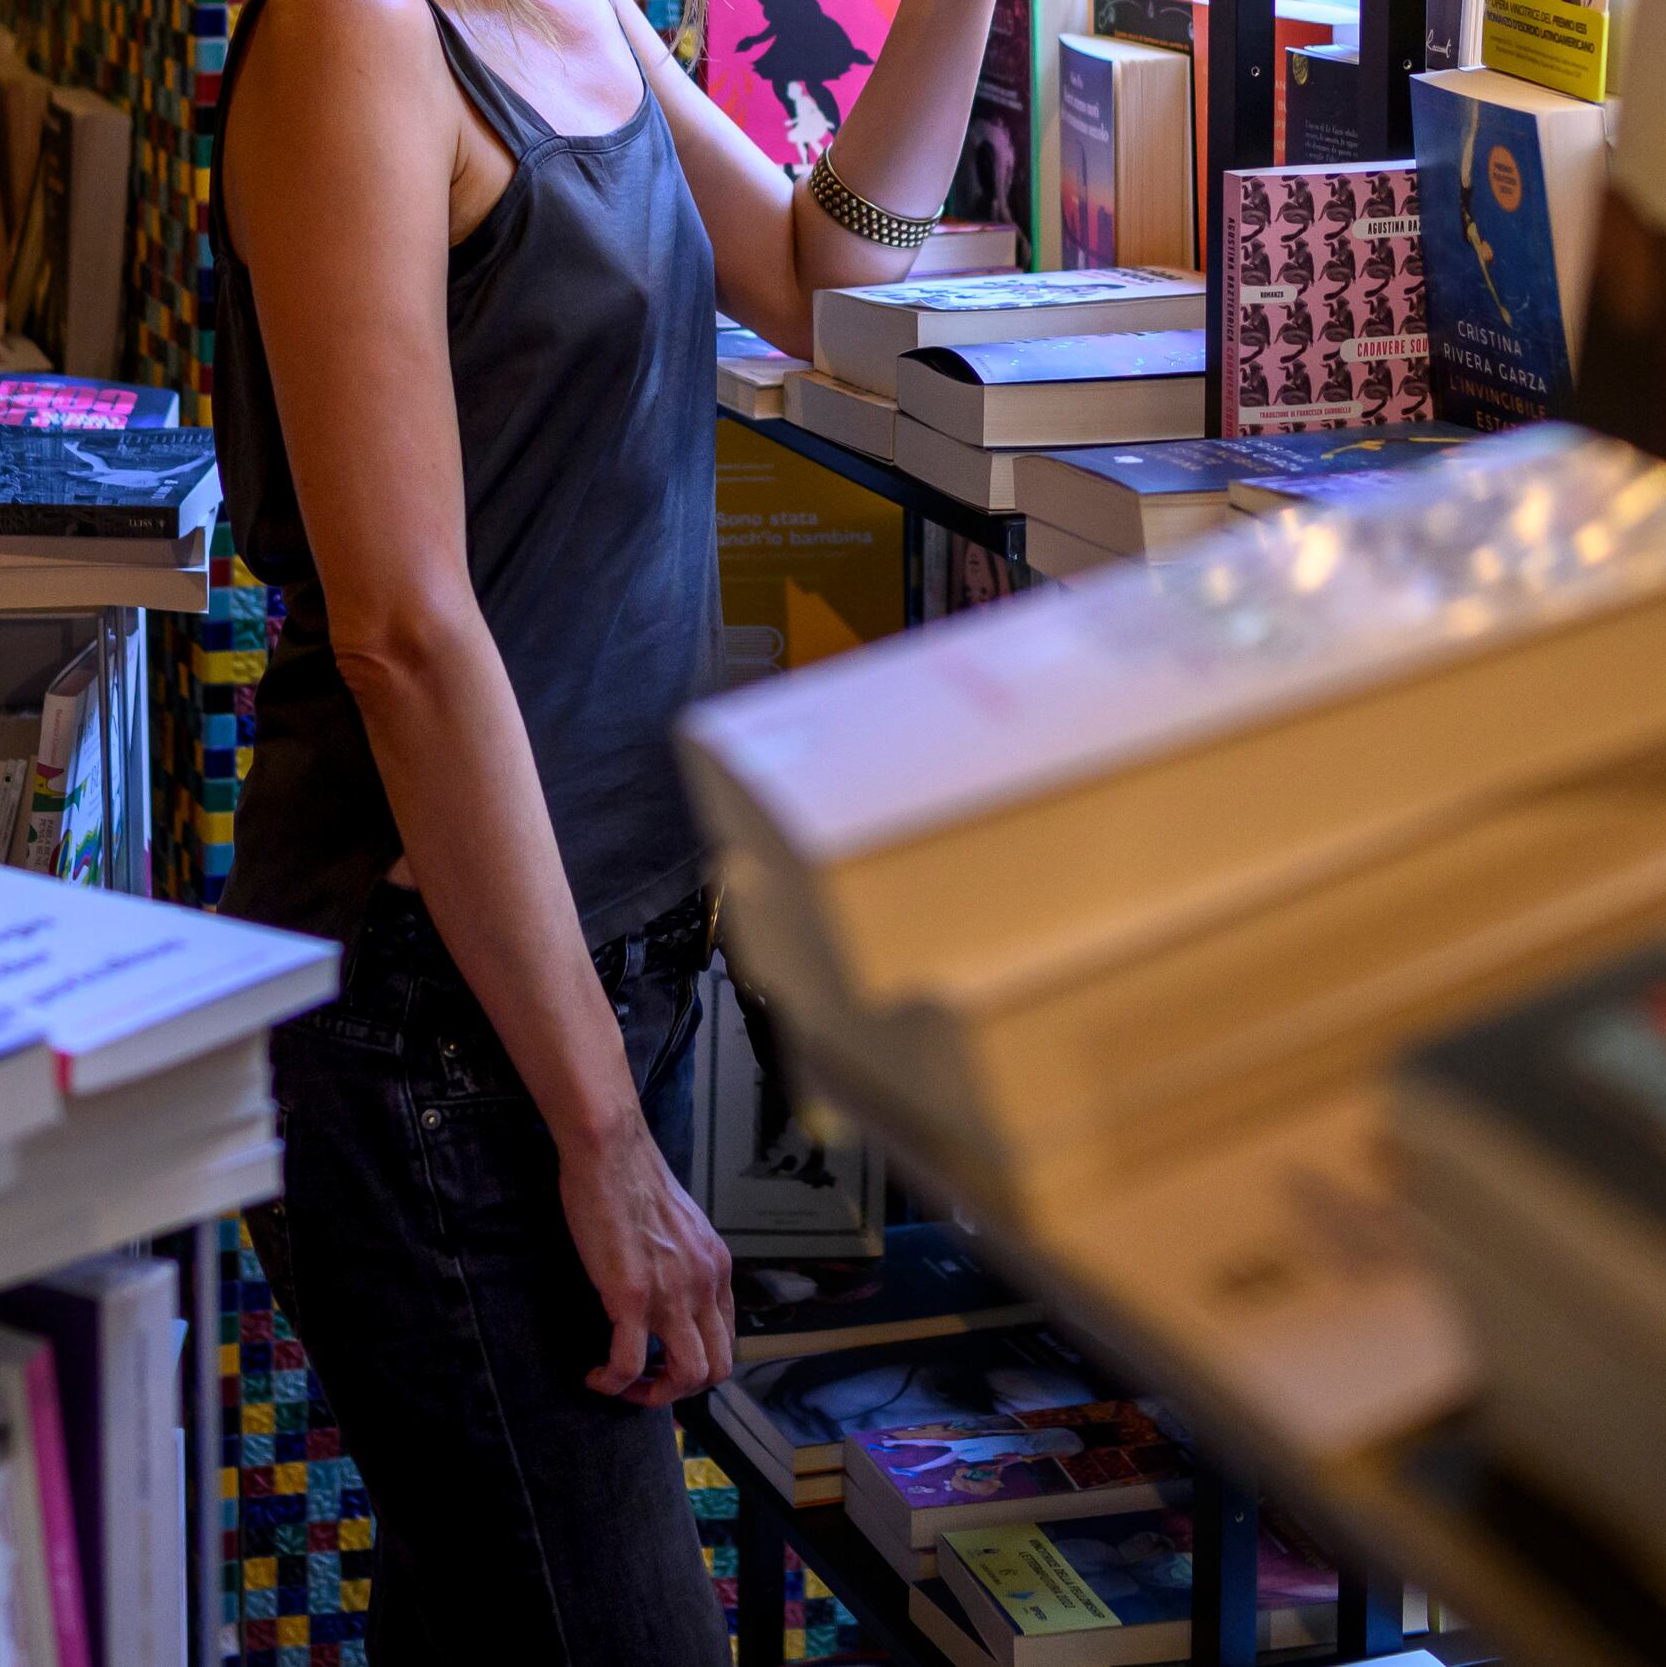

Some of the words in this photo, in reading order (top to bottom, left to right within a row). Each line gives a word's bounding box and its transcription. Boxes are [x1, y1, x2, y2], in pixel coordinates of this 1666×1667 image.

[1510, 2, 1542, 21] VINCITRICE
[1541, 27, 1595, 54] LATINOAMERICANO
[1367, 220, 1405, 234] AGUSTINA
[1227, 216, 1236, 271] AGUSTINA
[1259, 290, 1284, 299] ROMANZO
[1356, 339, 1406, 358] CADAVERE
[1457, 320, 1523, 358] CRISTINA
[1443, 342, 1493, 375] RIVERA
[1498, 362, 1548, 395] GARZA
[1448, 375, 1547, 423] L'INVINCIBILE
[768, 510, 819, 527] stata
[789, 529, 873, 547] bambina
